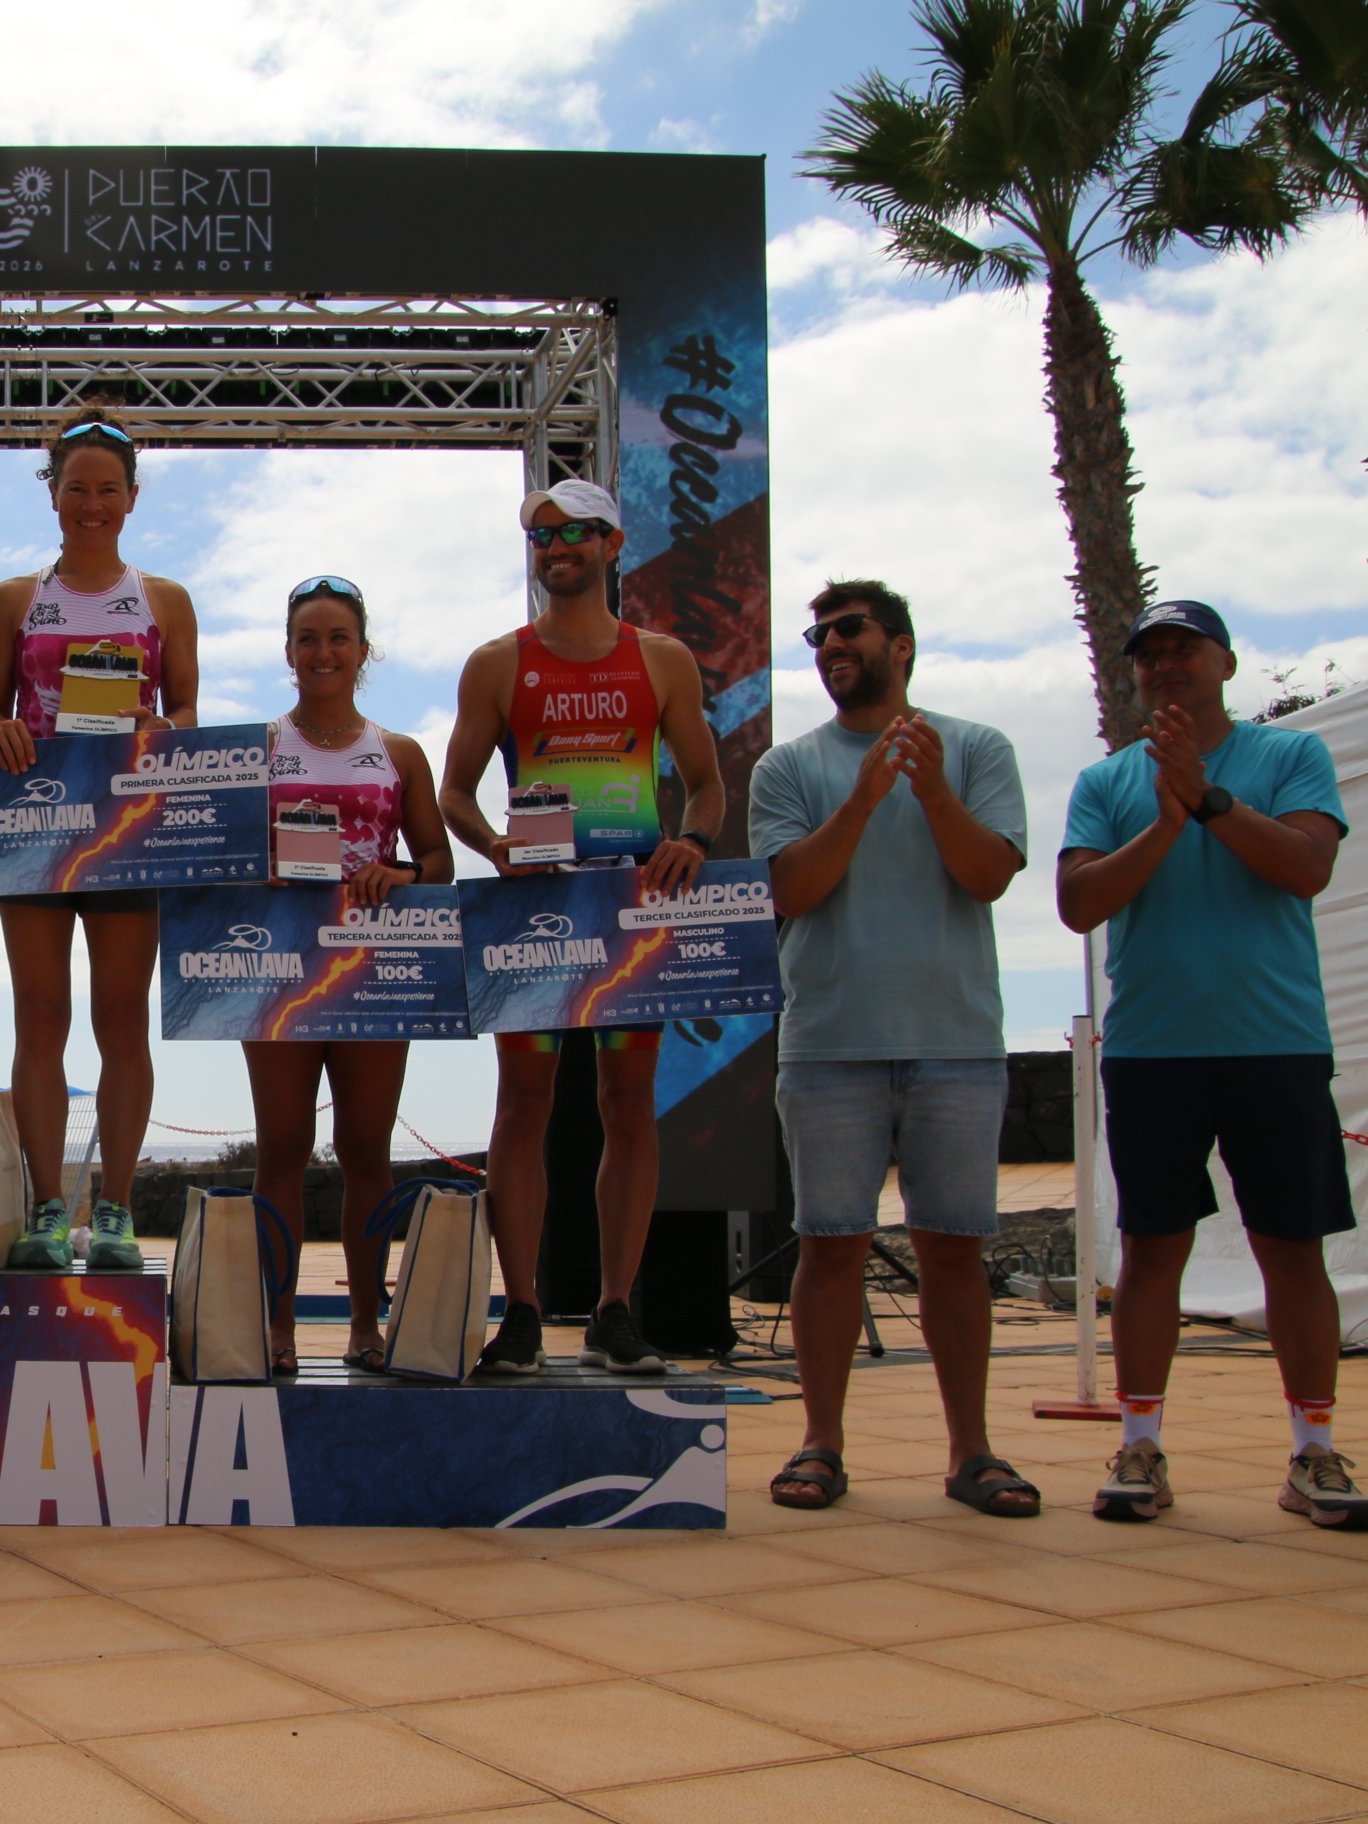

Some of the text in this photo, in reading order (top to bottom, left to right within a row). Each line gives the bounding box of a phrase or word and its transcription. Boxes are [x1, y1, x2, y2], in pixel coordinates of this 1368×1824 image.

[89, 169, 270, 206] PUERTO
[86, 215, 271, 251] CARMEN
[86, 261, 272, 271] LANZAROTE
[542, 690, 627, 723] ARTURO
[135, 746, 265, 774] OLÍMPICO
[548, 756, 622, 765] FUERTEVENTURA
[120, 773, 259, 789] PRIMERA CLASIFICADA 2025
[166, 794, 211, 804] FEMENINA
[162, 807, 217, 827] 200€
[643, 881, 769, 908] OLÍMPICO
[633, 906, 765, 923] TERCER CLASIFICADO 2025
[327, 933, 373, 941] TERCERA
[374, 933, 439, 941] CLASIFICADA
[673, 927, 725, 938] MASCULINO
[374, 951, 420, 959] FEMENINA
[678, 941, 727, 959] 100€
[375, 965, 424, 981] 100€
